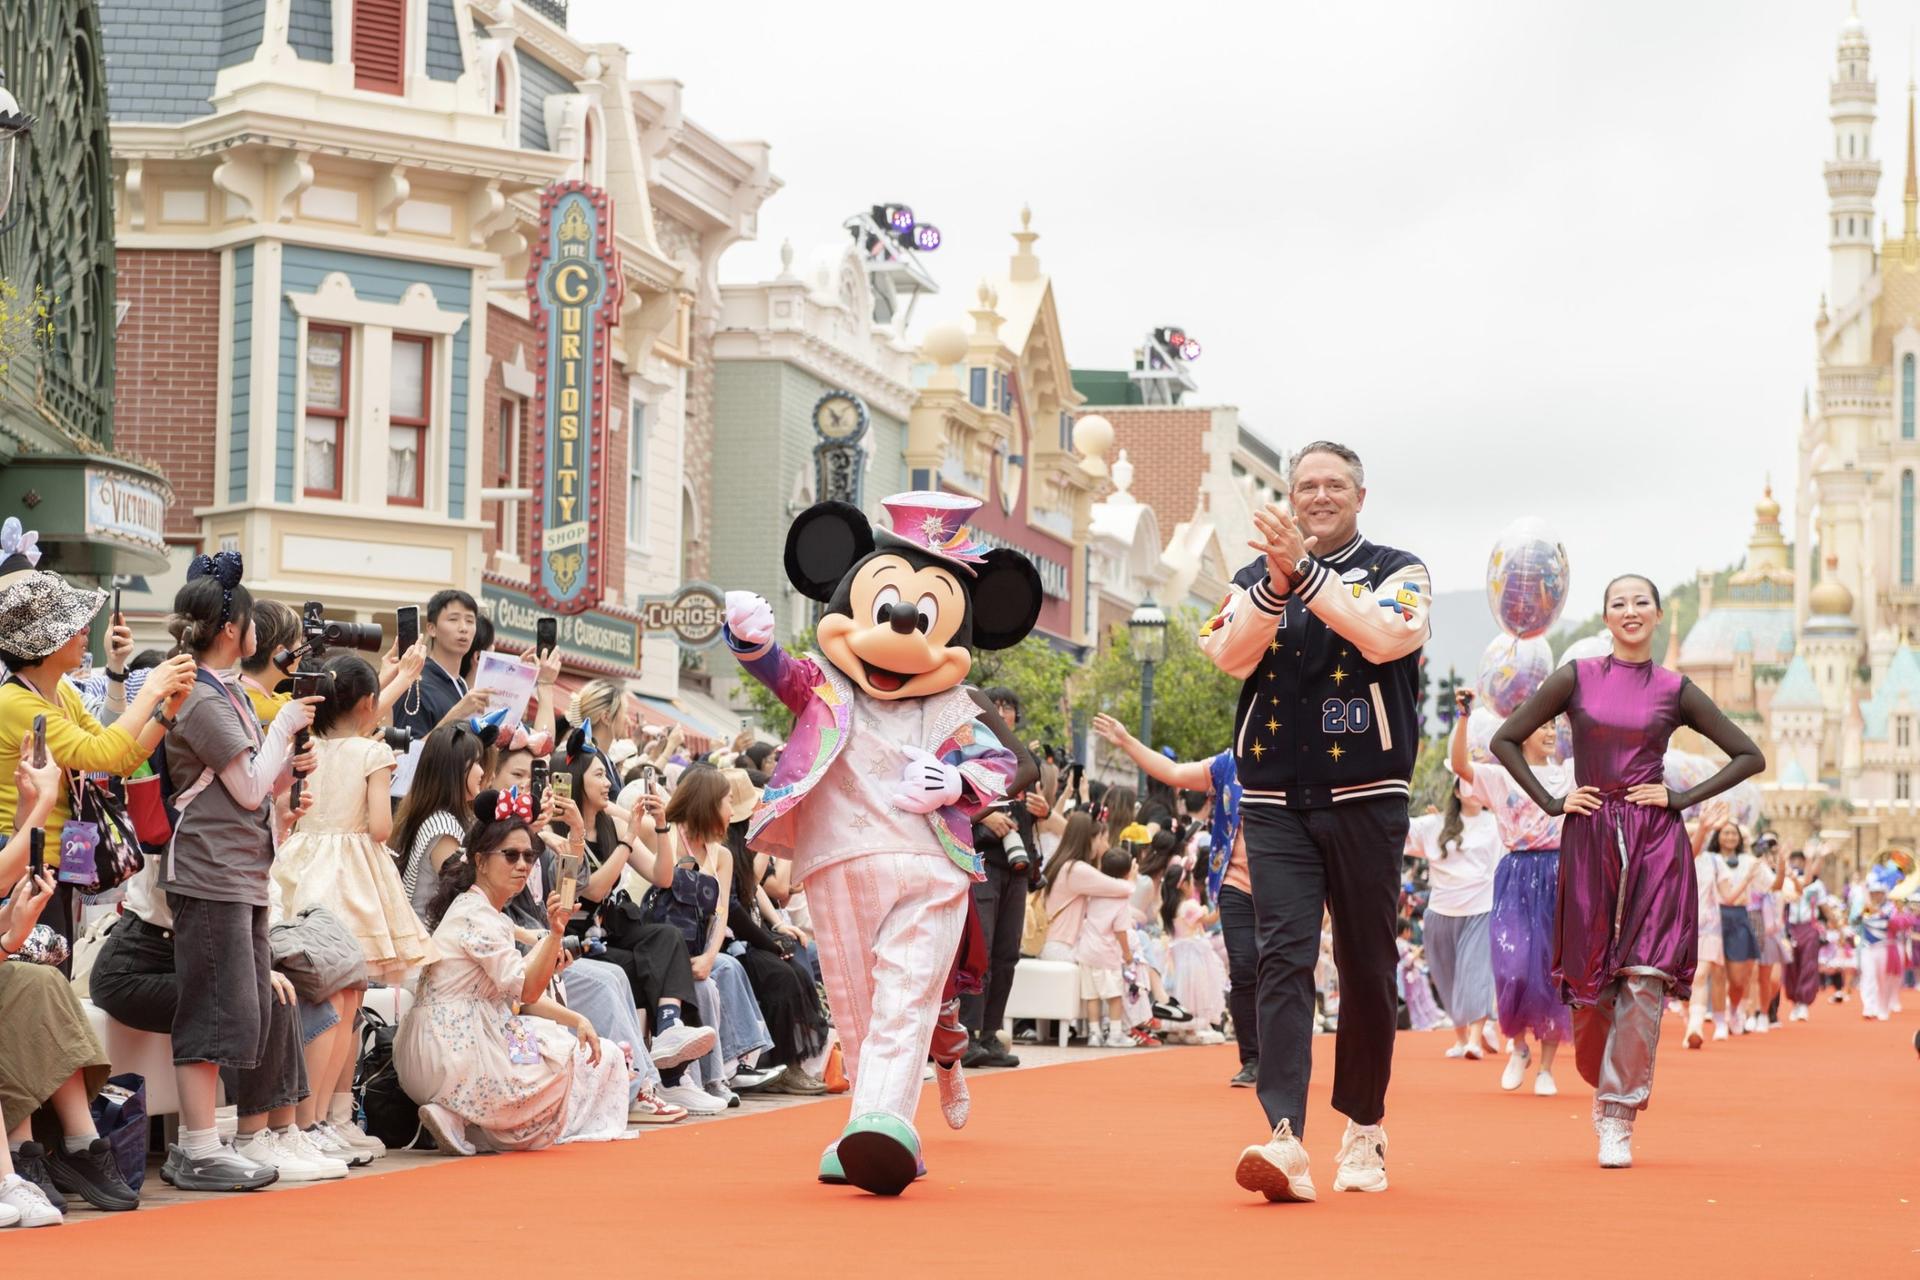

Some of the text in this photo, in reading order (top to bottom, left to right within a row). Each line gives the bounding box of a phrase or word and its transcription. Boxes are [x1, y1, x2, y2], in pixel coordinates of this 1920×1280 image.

[563, 244, 586, 258] THE
[555, 264, 588, 522] CURIOSITY
[547, 526, 586, 546] SHOP
[1322, 698, 1370, 733] 20
